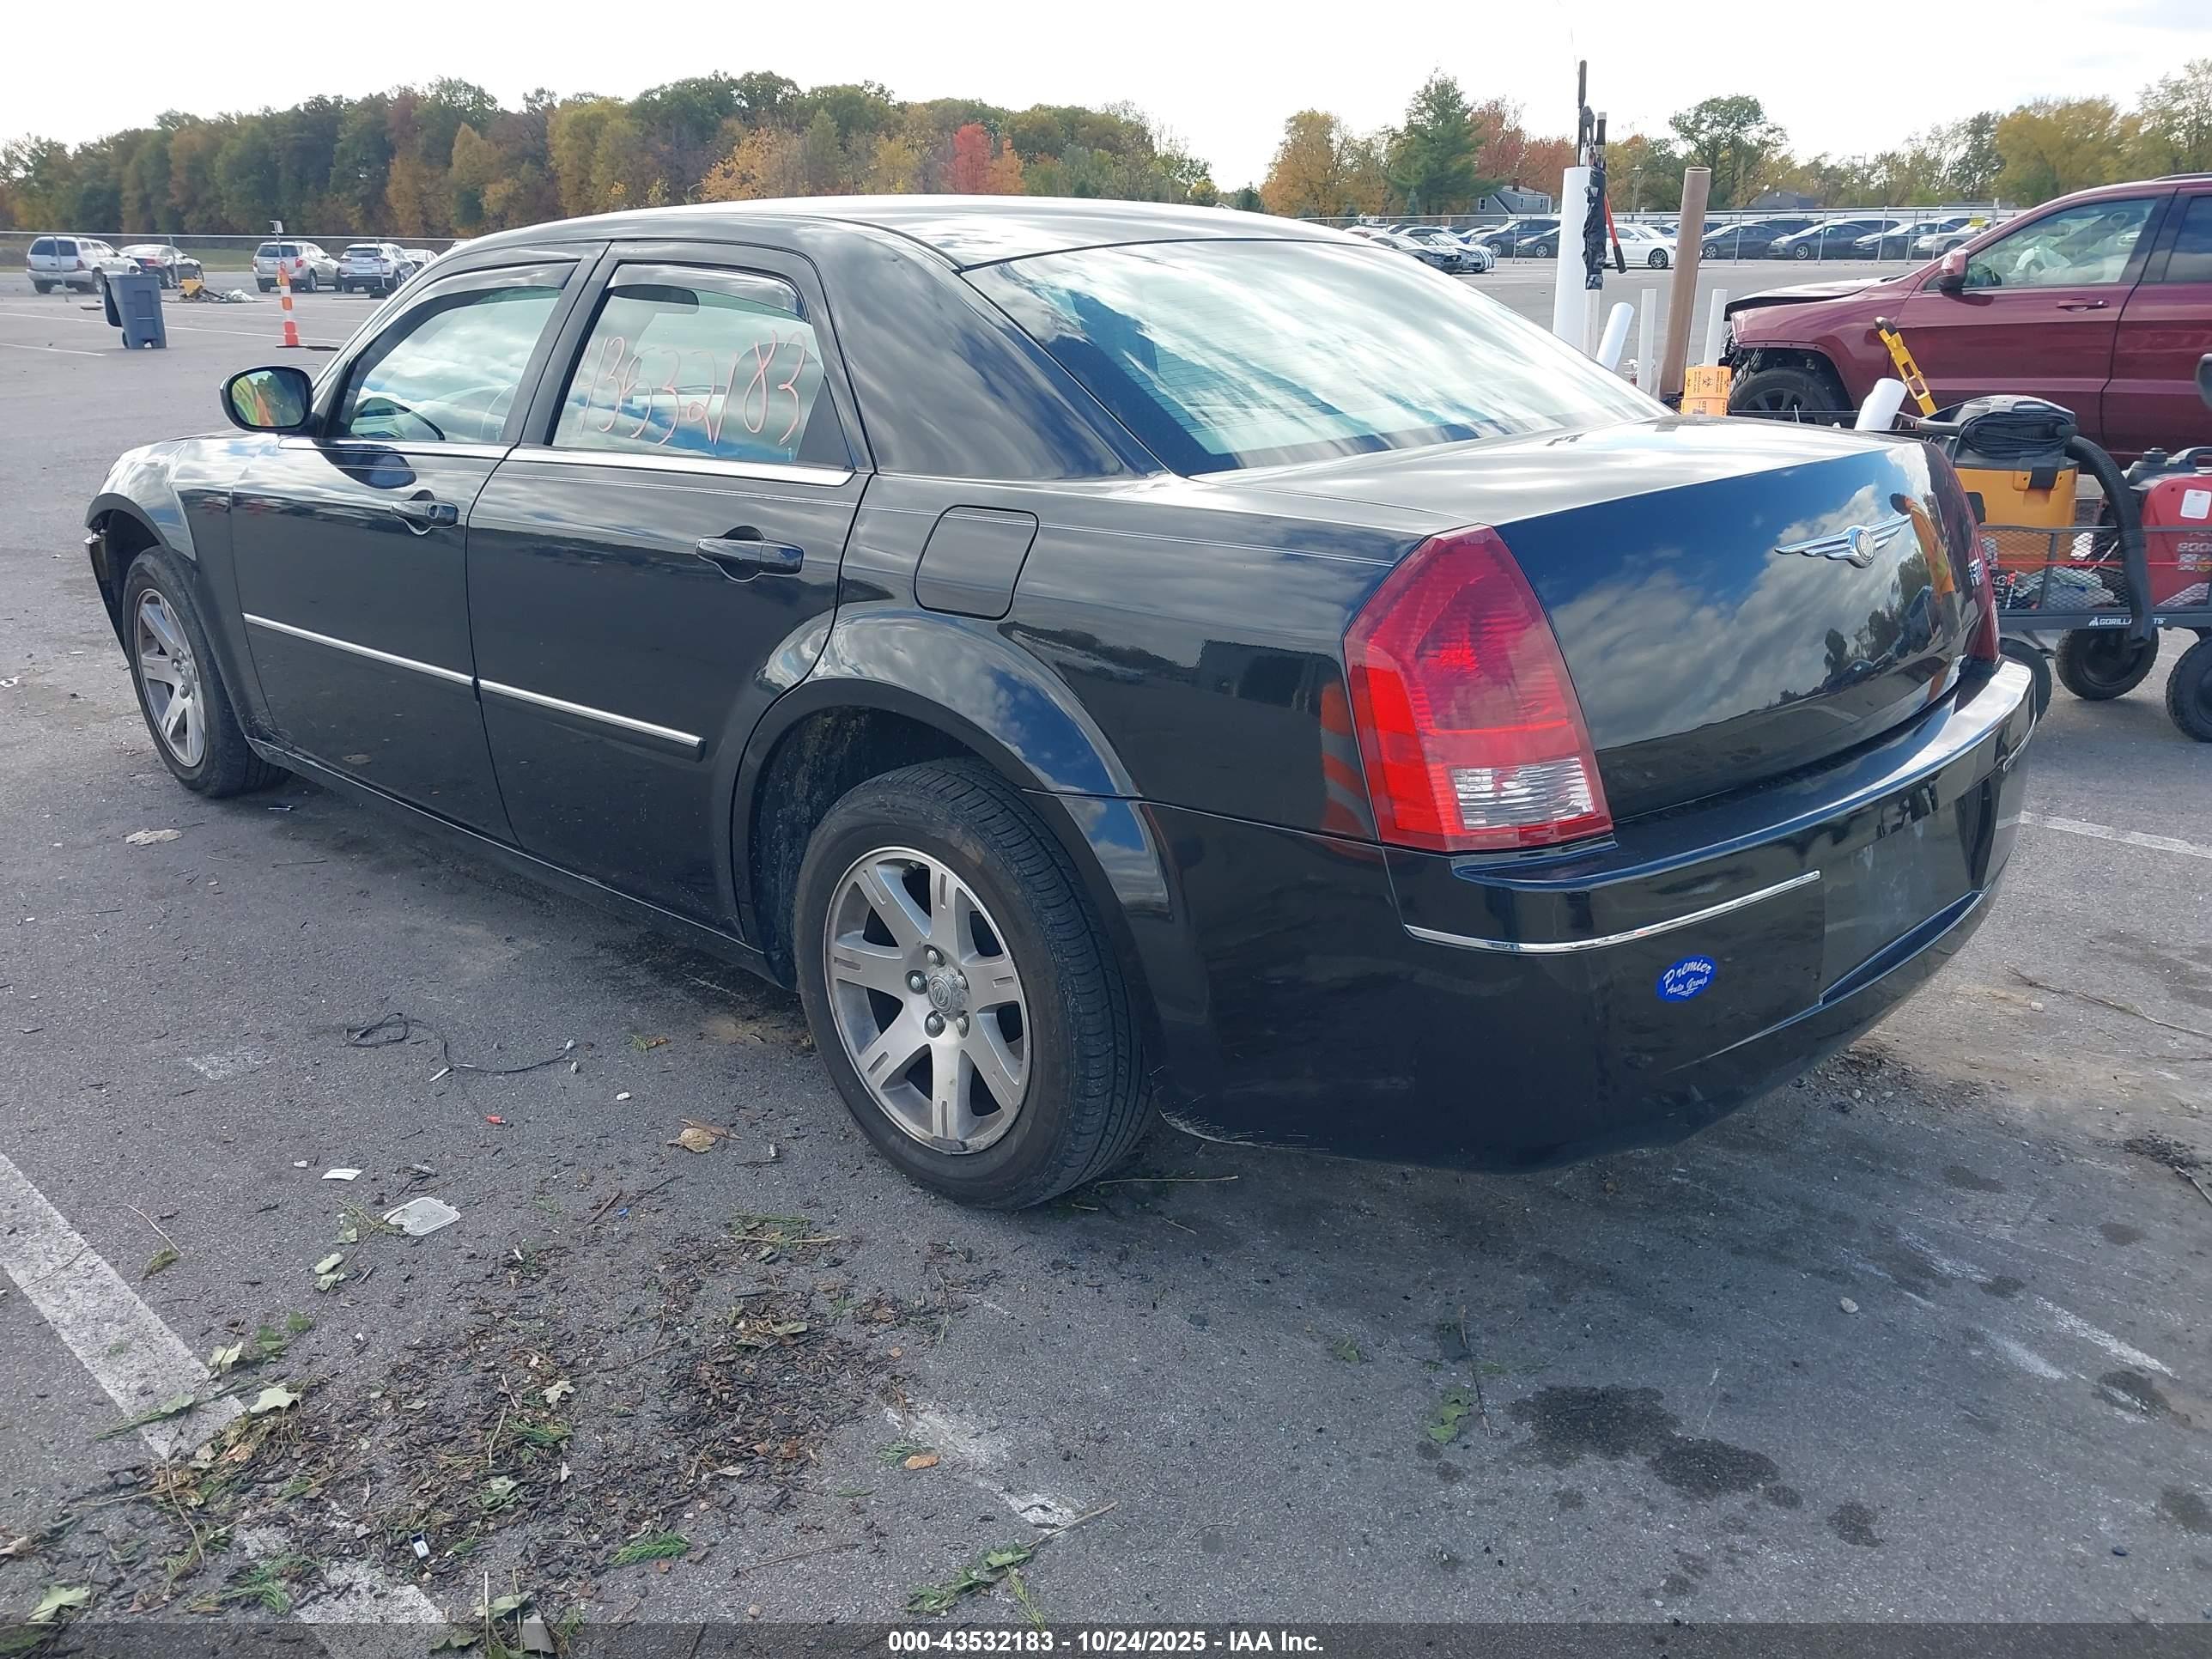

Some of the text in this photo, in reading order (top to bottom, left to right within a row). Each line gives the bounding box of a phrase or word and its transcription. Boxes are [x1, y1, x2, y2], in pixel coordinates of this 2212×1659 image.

[574, 329, 807, 447] 43532183
[1663, 958, 1712, 988] Premier
[1666, 975, 1708, 996] Auto Group
